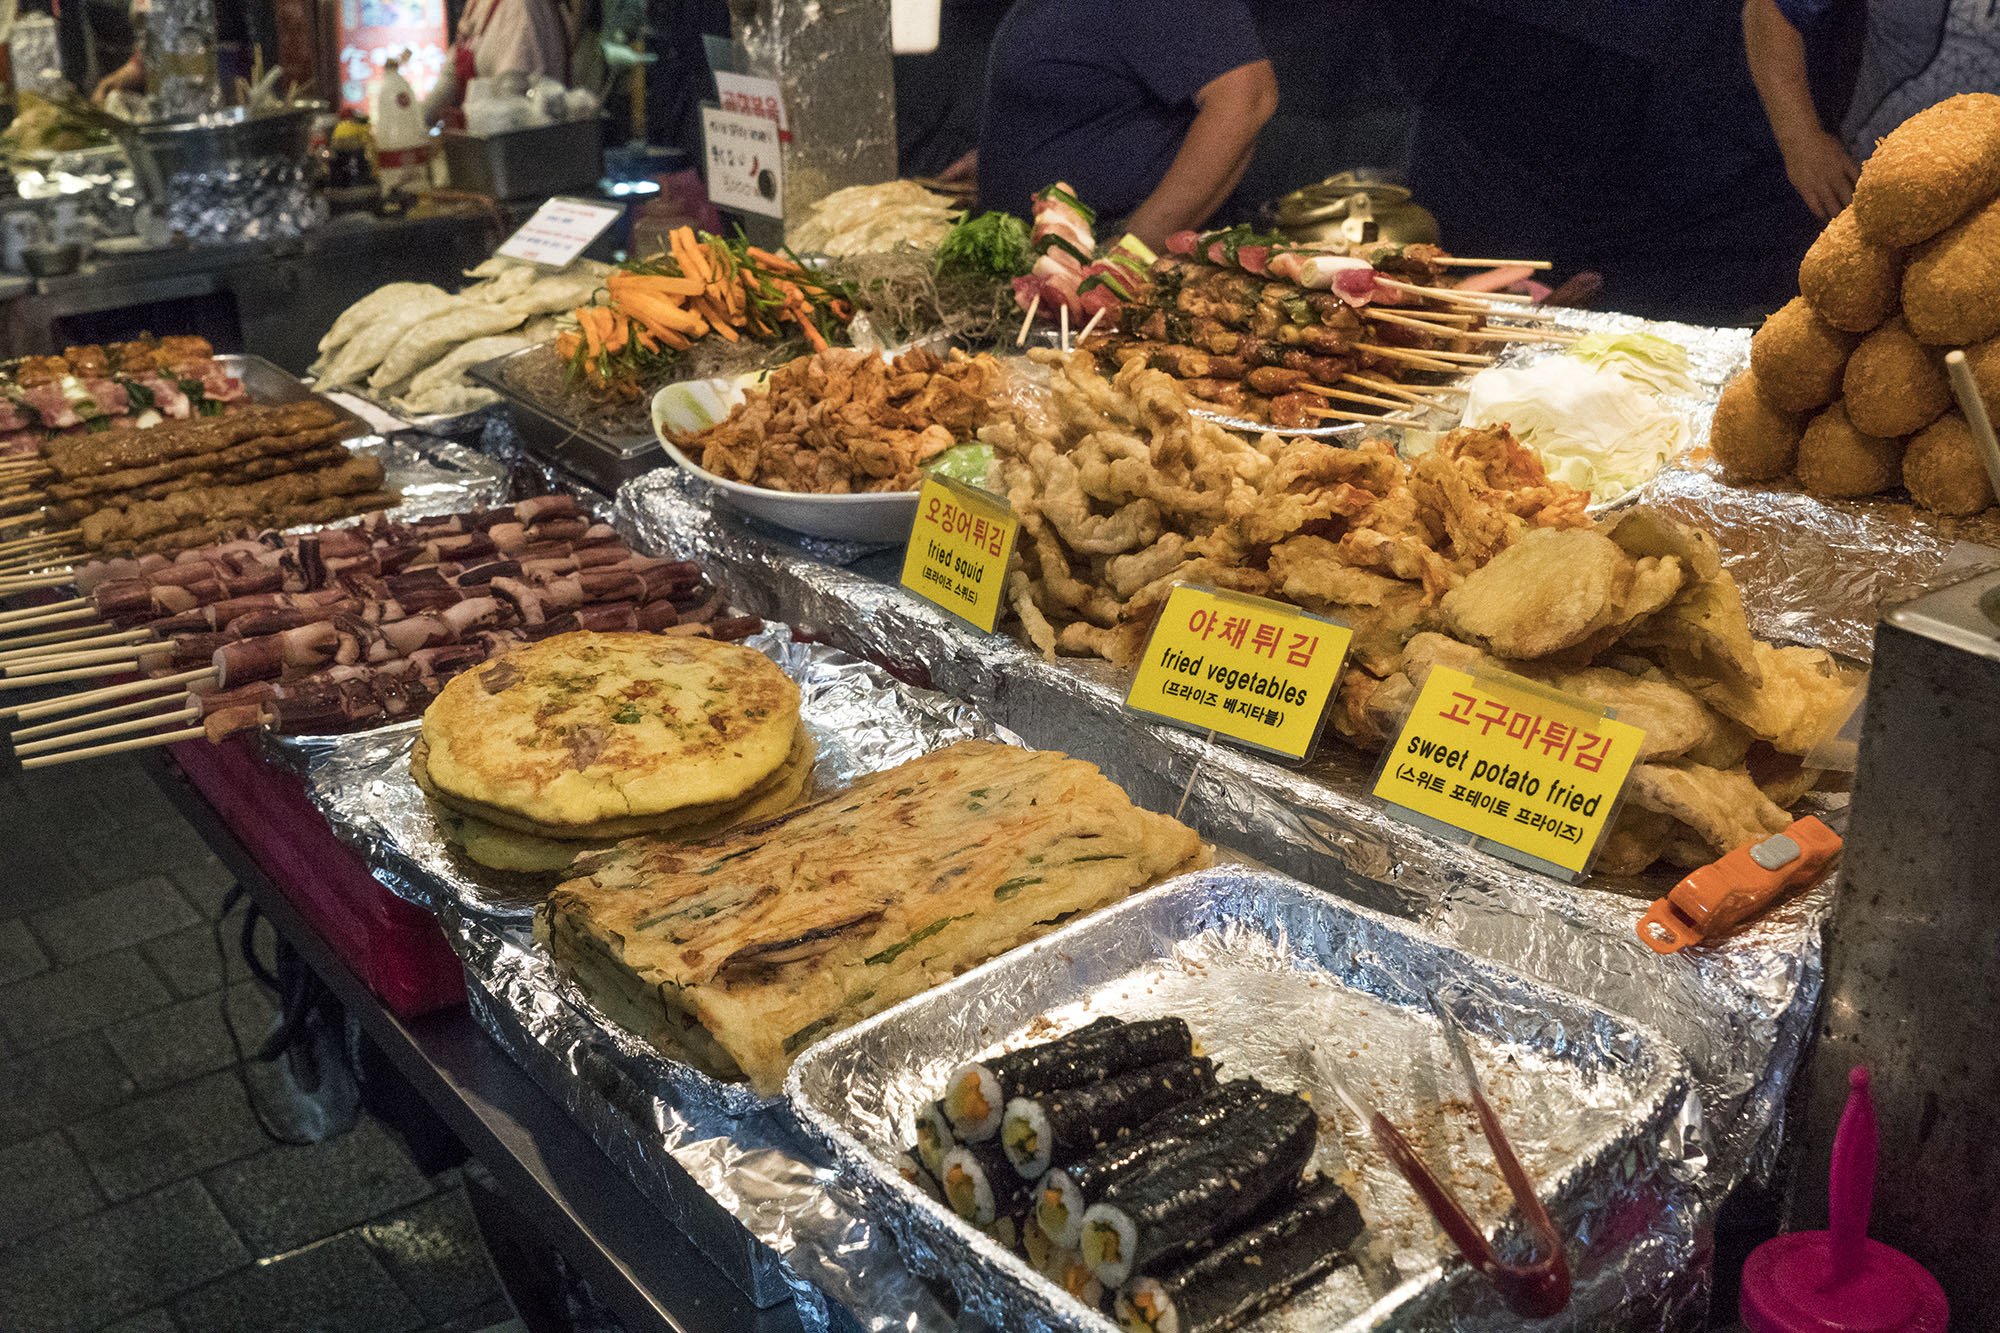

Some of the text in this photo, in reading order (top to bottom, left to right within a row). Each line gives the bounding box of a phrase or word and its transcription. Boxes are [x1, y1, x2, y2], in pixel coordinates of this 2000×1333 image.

[924, 497, 1006, 557] 오징어튀김
[922, 565, 952, 591] (프라이즈
[927, 540, 984, 583] fried squid
[1160, 648, 1308, 706] fried vegetables
[1162, 679, 1285, 728] (프라이즈 베지타블)
[1439, 691, 1612, 773] 고구마튀김
[1395, 763, 1584, 844] (스위트 포테이토 프라이즈)
[1407, 736, 1602, 818] sweet potato fried
